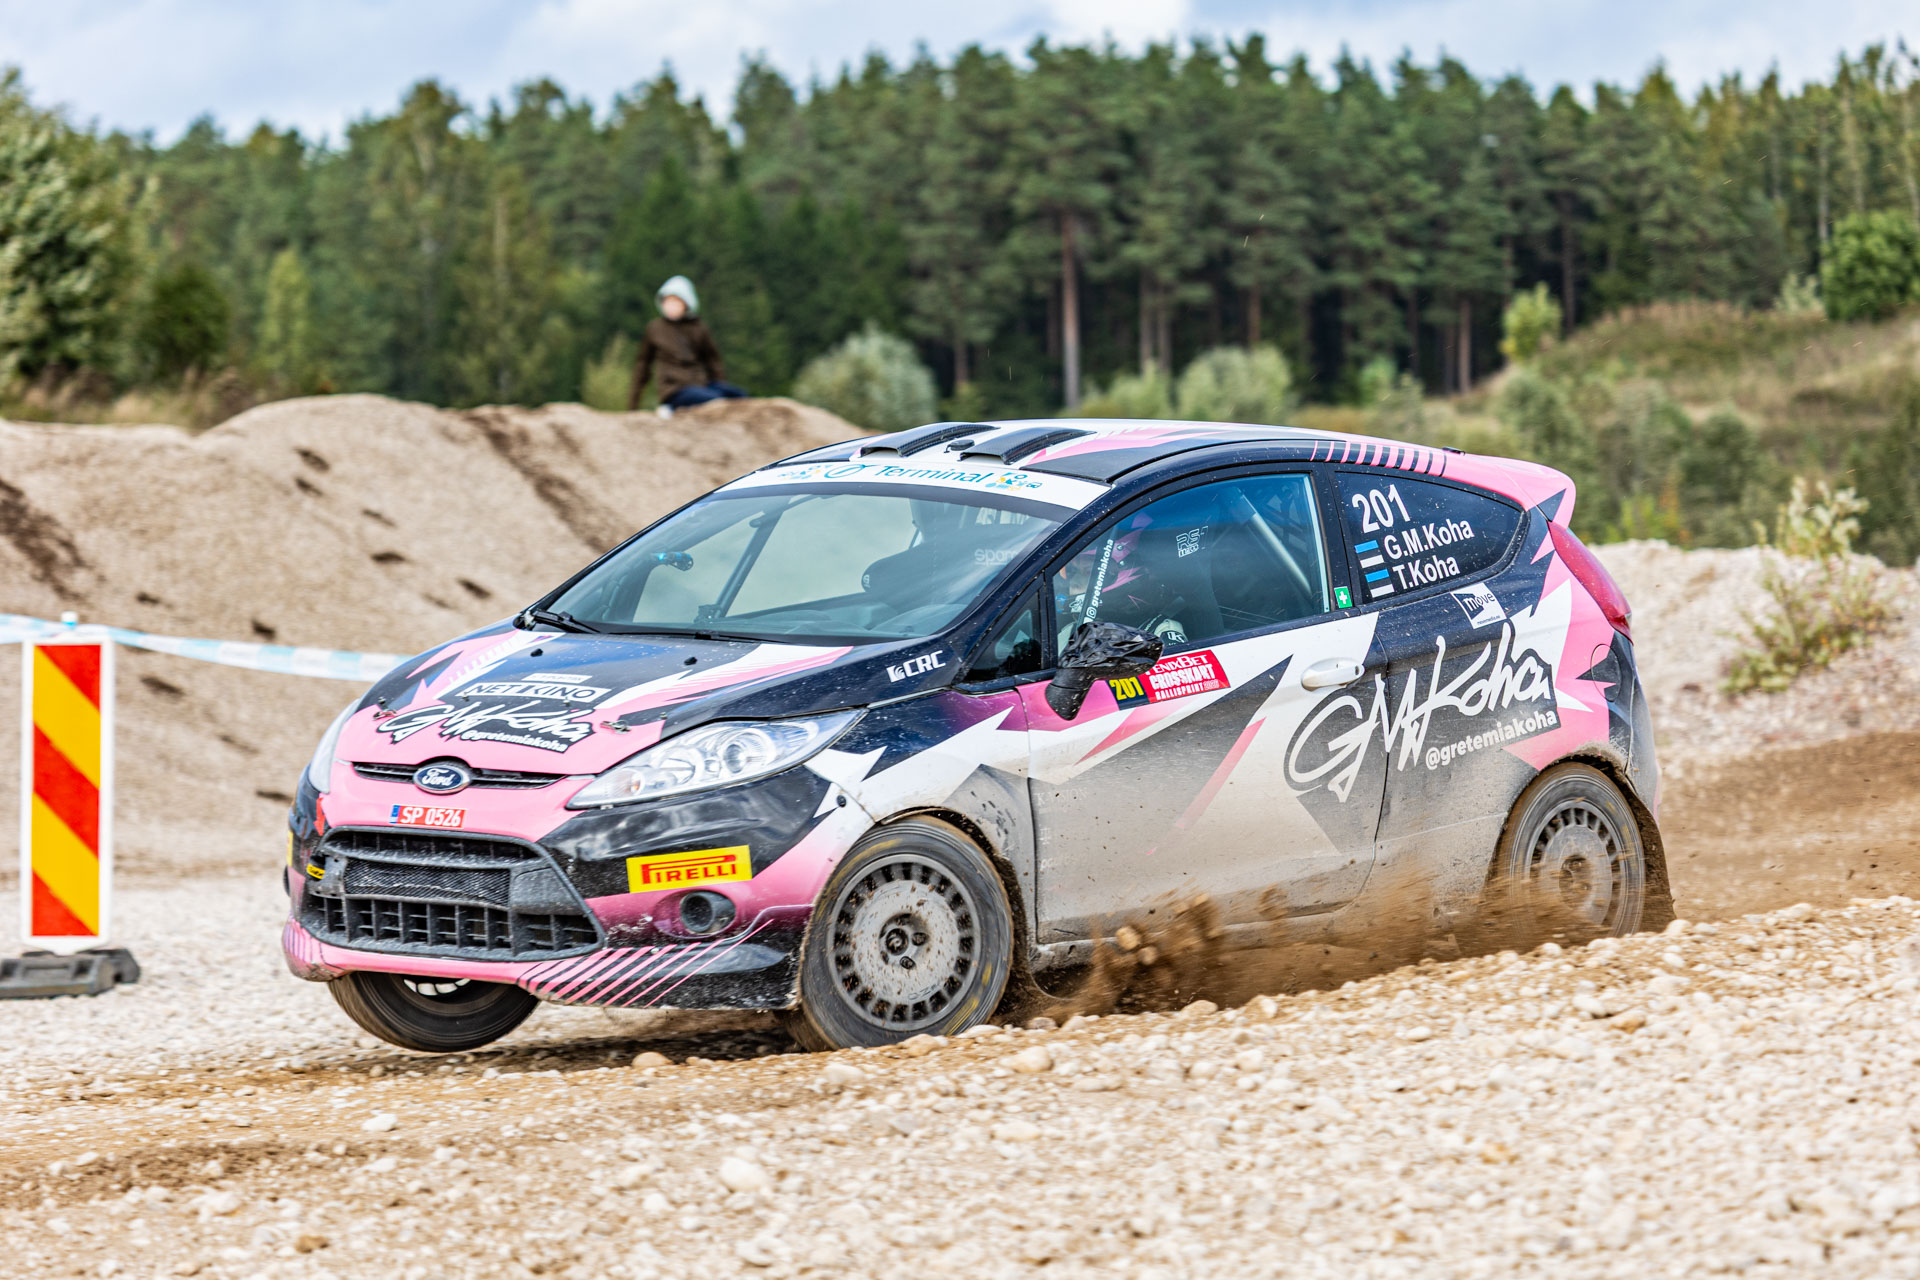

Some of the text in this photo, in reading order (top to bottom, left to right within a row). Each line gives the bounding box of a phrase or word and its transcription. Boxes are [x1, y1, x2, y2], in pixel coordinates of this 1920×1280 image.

[876, 466, 995, 482] Terminal
[1351, 484, 1411, 534] 201
[1383, 518, 1475, 560] G.M.Koha
[1392, 555, 1461, 590] T.Koha
[1462, 593, 1496, 612] move
[902, 650, 946, 677] CRC
[1109, 676, 1144, 700] 201
[1149, 664, 1216, 690] CROSSKART
[1155, 682, 1204, 700] RALLISPRINT
[1425, 709, 1558, 770] @gretemiakoha
[421, 768, 456, 786] Ford
[400, 807, 462, 827] SP 0526
[641, 854, 737, 885] PIRELLI
